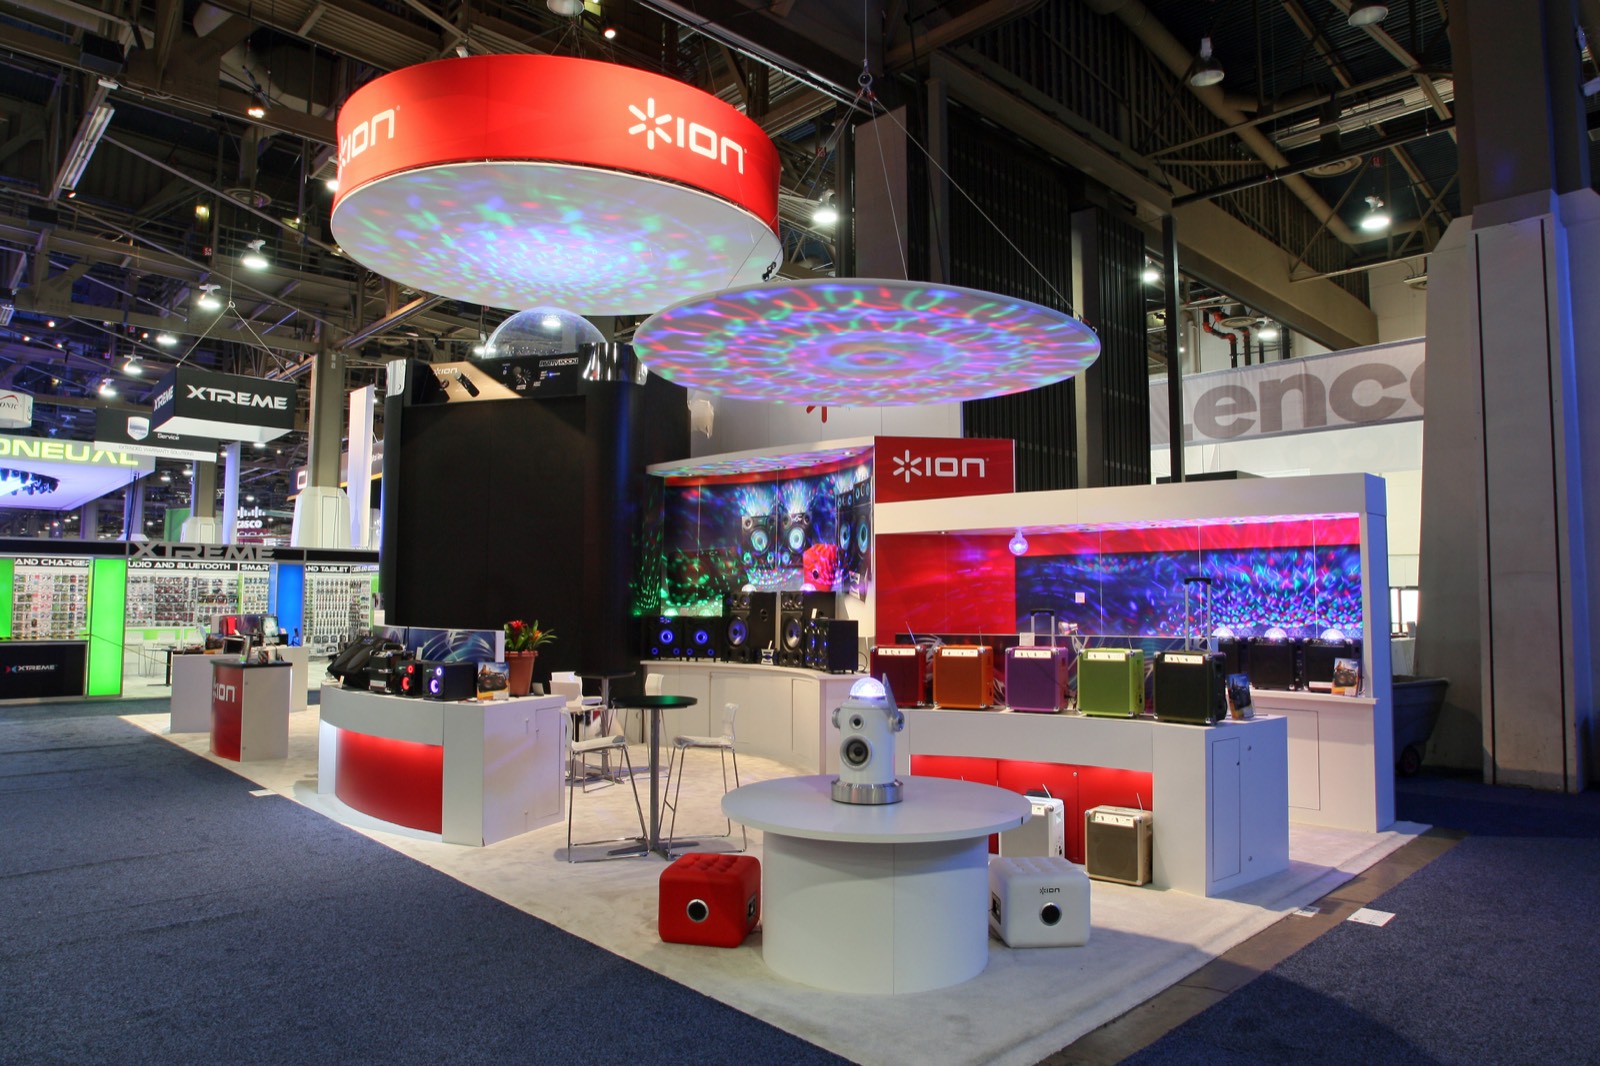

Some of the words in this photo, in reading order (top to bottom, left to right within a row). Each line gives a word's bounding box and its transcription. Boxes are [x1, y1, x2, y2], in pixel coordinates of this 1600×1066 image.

[676, 118, 745, 174] ION
[153, 385, 174, 412] XTREME
[186, 384, 288, 410] XTREME
[1183, 362, 1425, 441] enc
[157, 432, 180, 441] Service
[925, 456, 985, 478] ION
[14, 558, 39, 566] AND
[131, 541, 276, 561] XTREME
[177, 562, 231, 570] BLUETOOTH
